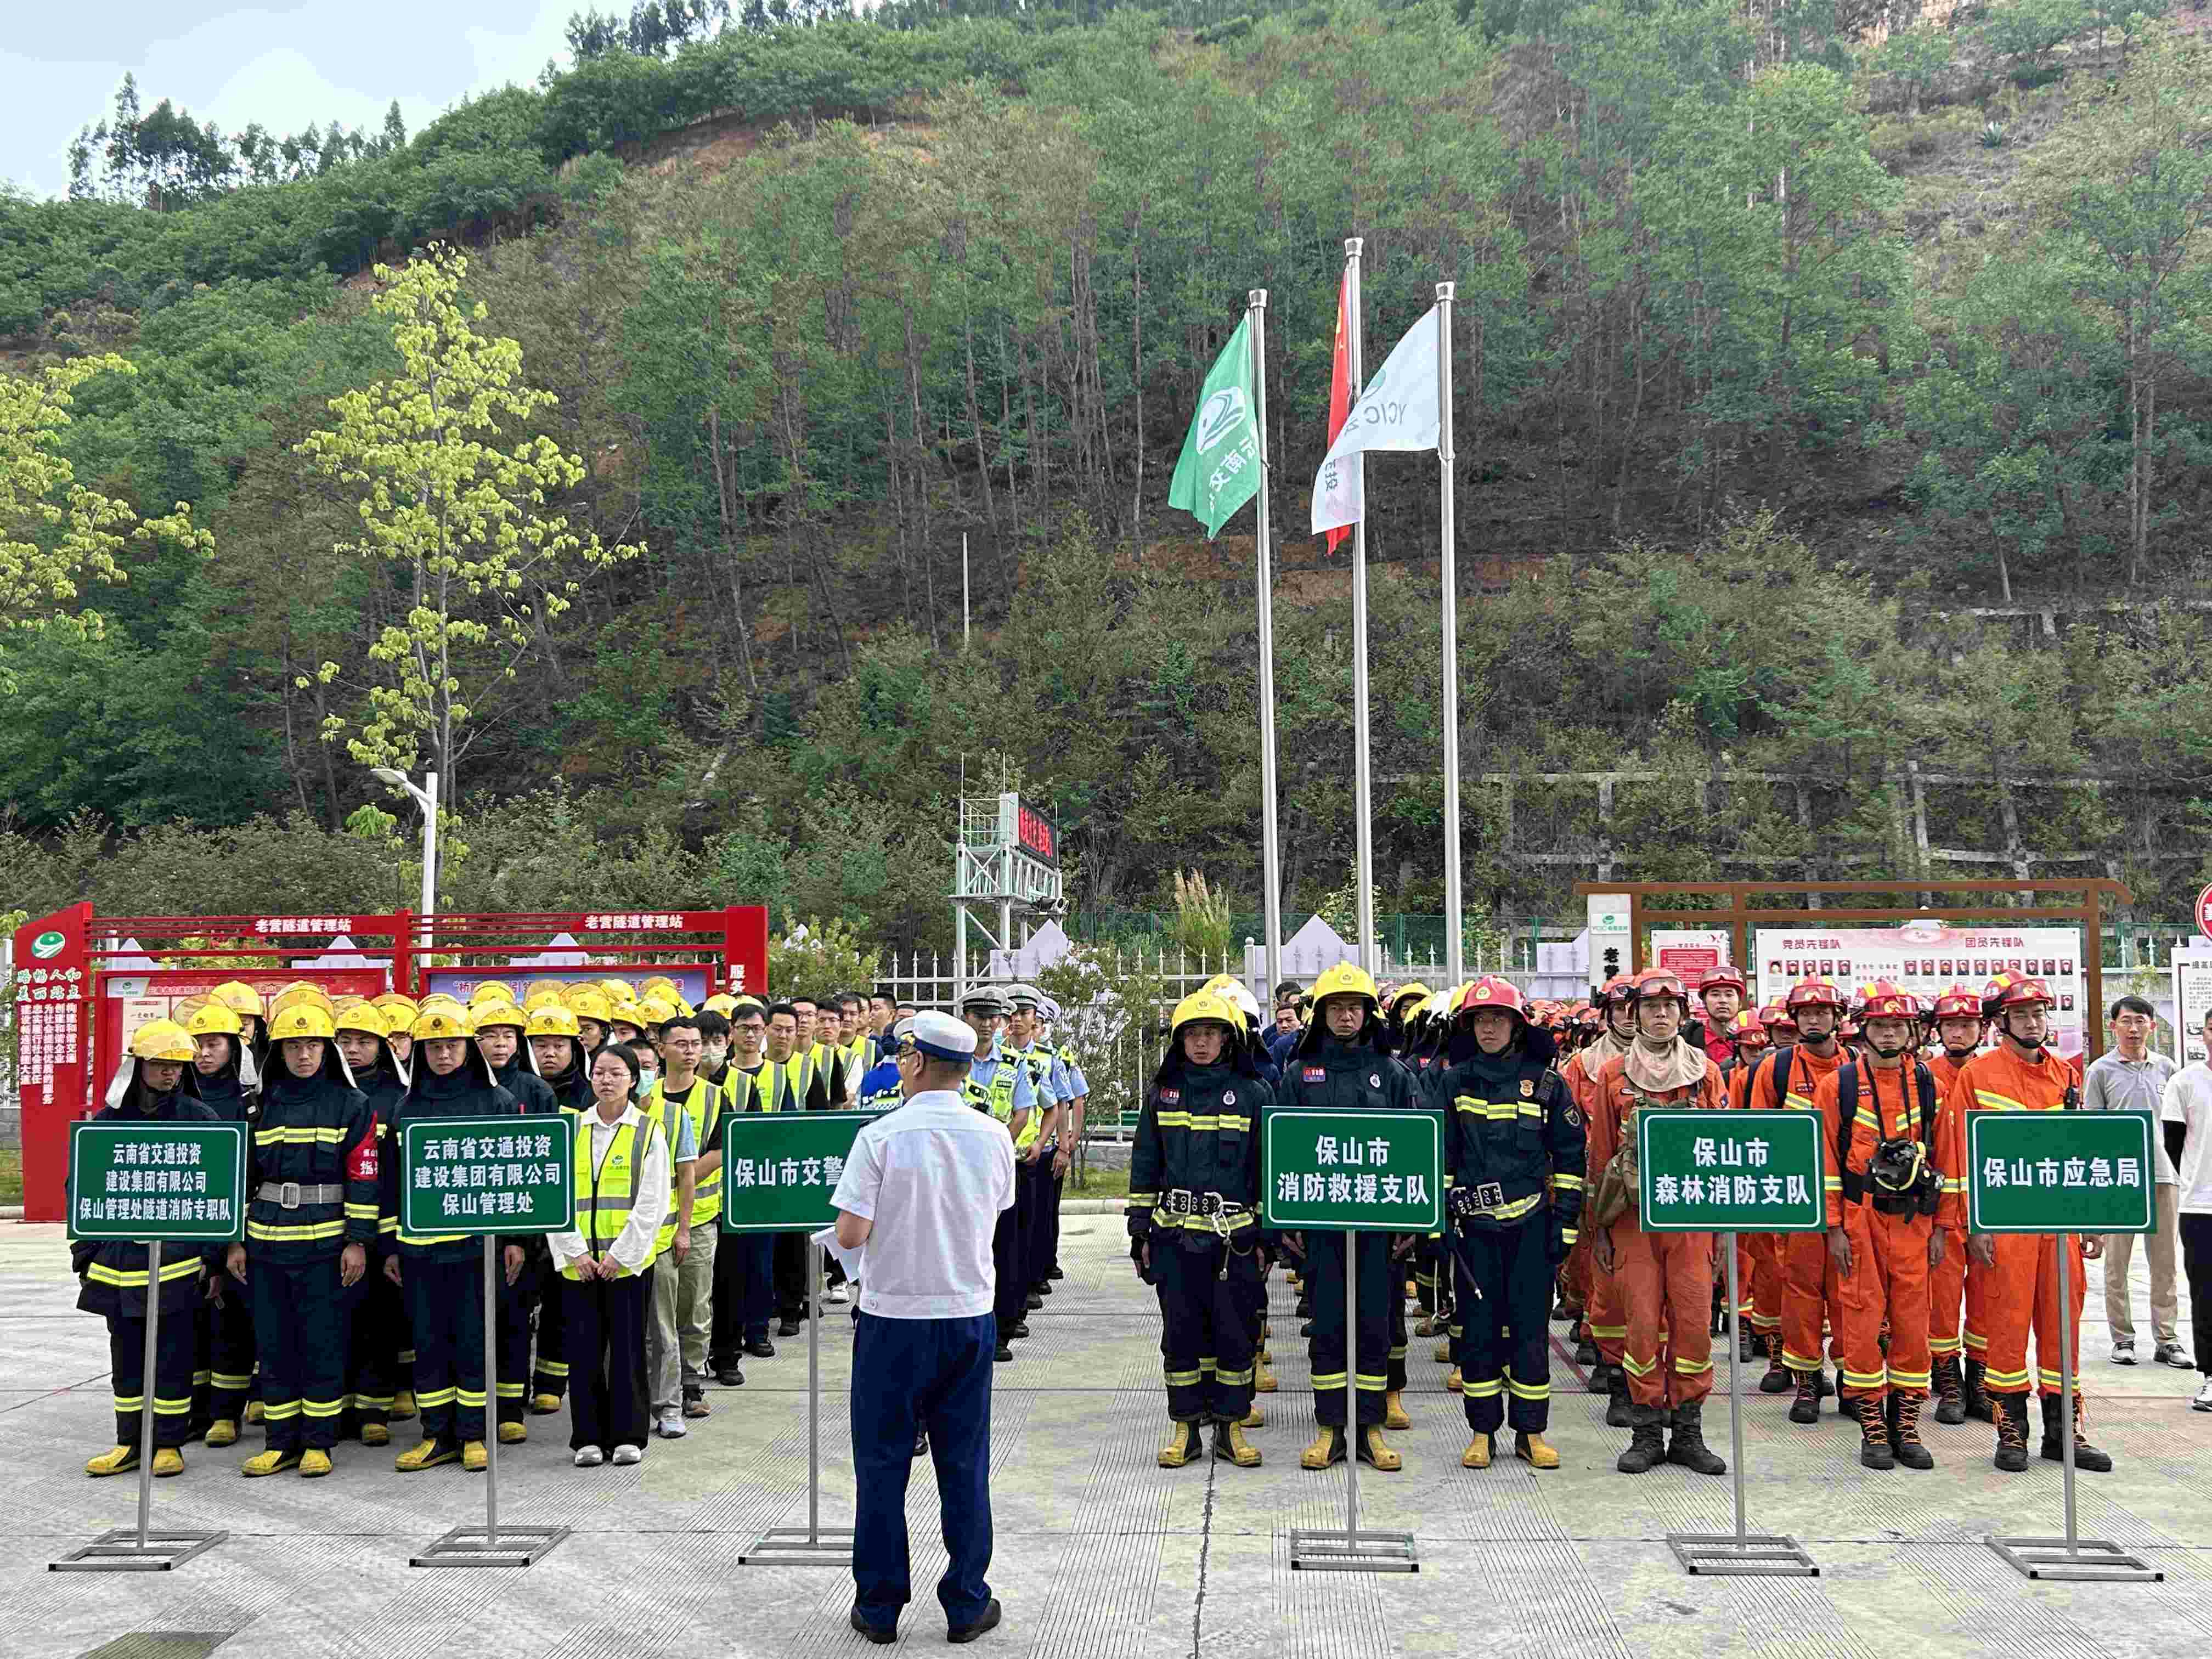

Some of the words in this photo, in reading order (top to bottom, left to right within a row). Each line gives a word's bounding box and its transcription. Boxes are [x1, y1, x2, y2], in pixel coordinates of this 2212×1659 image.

[255, 918, 351, 933] 老营隧道管理站
[584, 915, 684, 929] 老营隧道管理站
[1782, 939, 1841, 949] 党员先锋队
[1965, 937, 2025, 947] 团员先锋队
[17, 967, 81, 984] 路畅人和
[113, 1143, 201, 1165] 云南省交通投资
[424, 1135, 551, 1160] 云南省交通投资
[1315, 1135, 1390, 1166] 保山市
[1692, 1136, 1769, 1167] 保山市
[105, 1170, 206, 1193] 建设集团有限公司
[415, 1163, 561, 1188] 建设集团有限公司
[735, 1156, 844, 1187] 保山市交警
[1983, 1156, 2140, 1188] 保山市应急局
[1277, 1172, 1430, 1205] 消防救援支队
[1655, 1173, 1811, 1205] 森林消防支队
[80, 1198, 230, 1220] 保山管理处隧道消防专职队
[443, 1192, 533, 1216] 保山管理处
